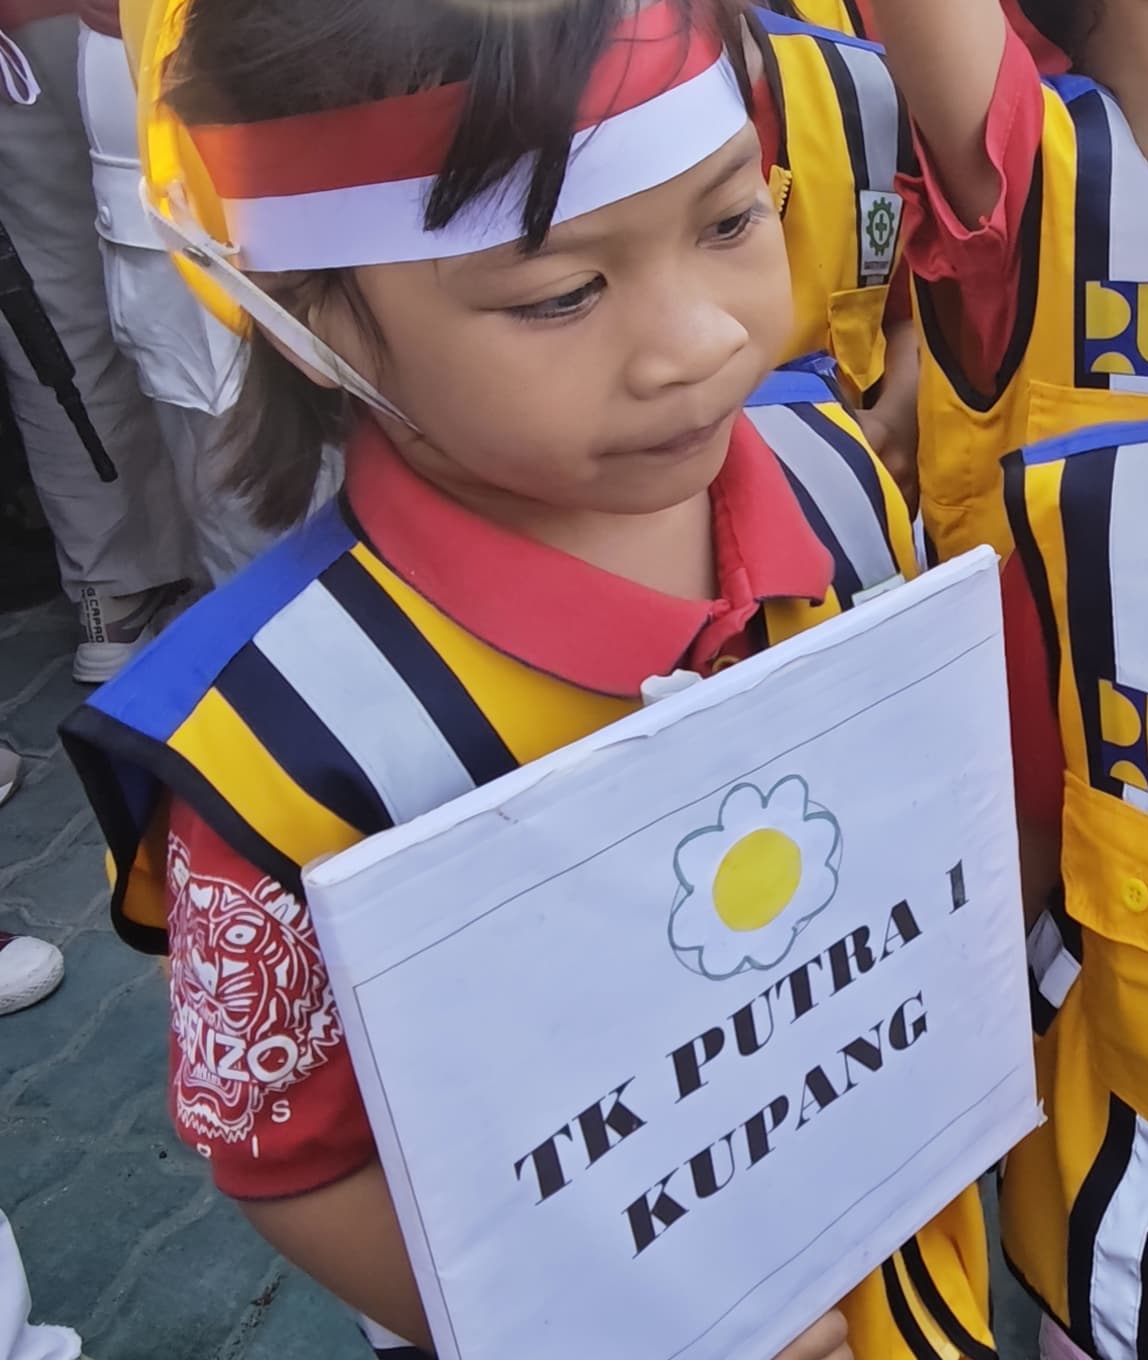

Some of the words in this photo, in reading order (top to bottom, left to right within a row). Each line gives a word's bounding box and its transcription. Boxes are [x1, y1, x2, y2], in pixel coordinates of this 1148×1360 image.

[513, 1076, 648, 1206] TK
[665, 899, 923, 1104] PUTRA
[620, 990, 928, 1259] KUPANG
